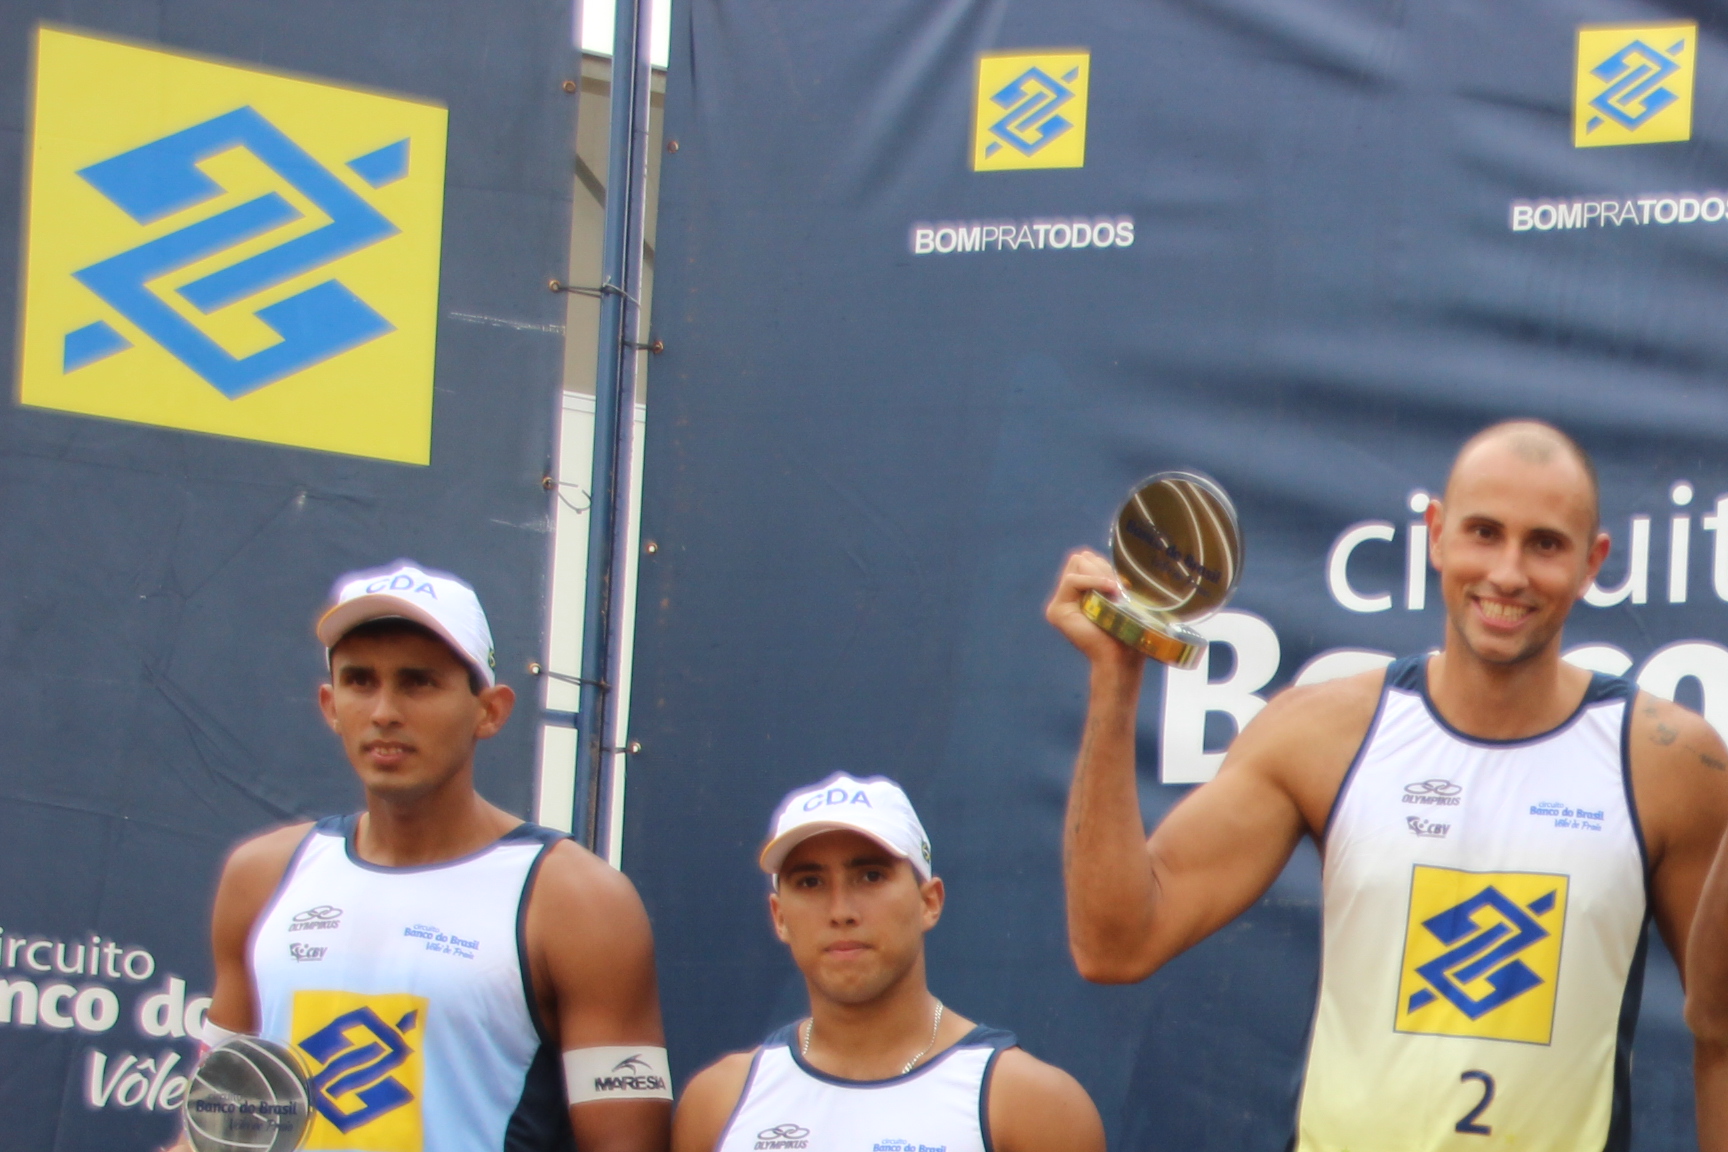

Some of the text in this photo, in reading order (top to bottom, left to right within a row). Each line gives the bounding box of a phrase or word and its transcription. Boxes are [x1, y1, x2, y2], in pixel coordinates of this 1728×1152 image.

[913, 220, 1135, 254] BOMPRATODOS
[366, 574, 438, 600] CDA
[803, 788, 873, 812] CDA
[1401, 794, 1461, 806] OLYMPIKUS
[1530, 806, 1604, 820] Banco do Brasil
[1427, 823, 1452, 835] CBV
[288, 920, 340, 932] OLYMPIKUS
[404, 927, 480, 950] Banco do Brasil
[0, 926, 155, 980] ircuito
[306, 947, 328, 958] CBV
[0, 977, 119, 1032] nco
[89, 1050, 190, 1111] Vôle
[594, 1076, 666, 1092] MARESIA
[196, 1099, 298, 1116] Banco do Brasil
[1455, 1071, 1494, 1136] 2
[754, 1140, 809, 1150] OLYMPIKUS
[873, 1143, 901, 1152] Banco
[903, 1143, 916, 1152] do
